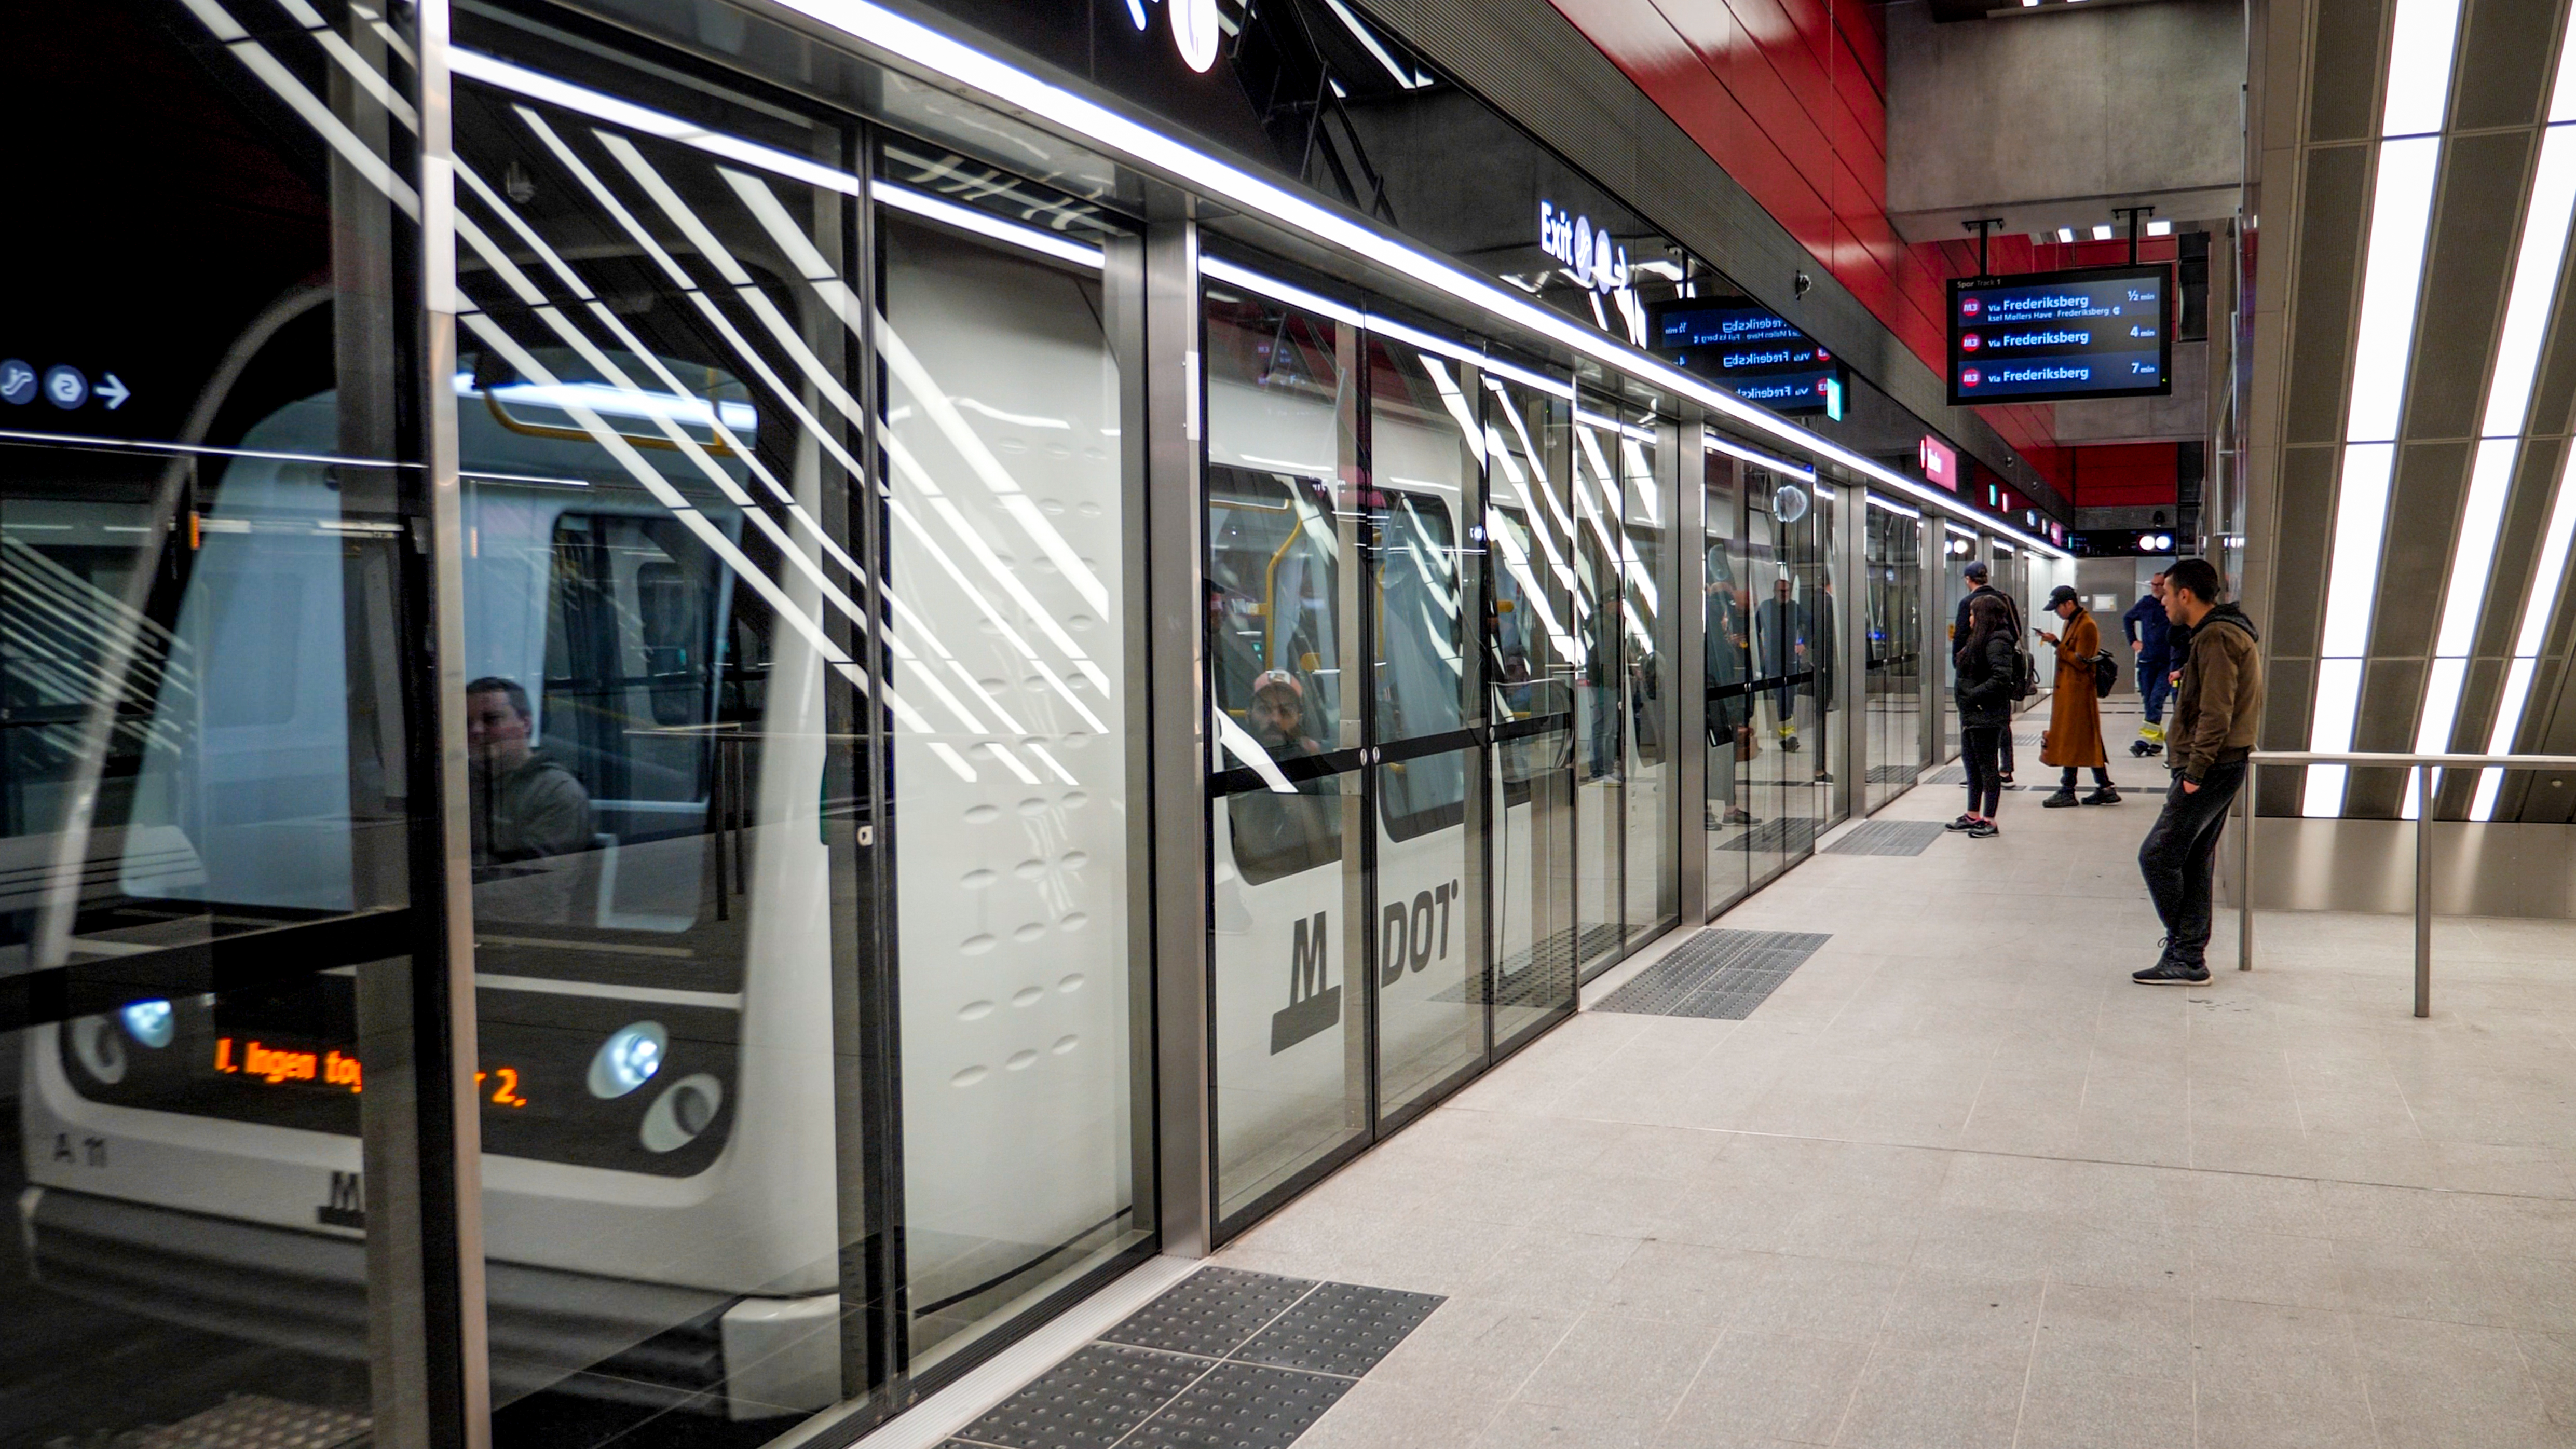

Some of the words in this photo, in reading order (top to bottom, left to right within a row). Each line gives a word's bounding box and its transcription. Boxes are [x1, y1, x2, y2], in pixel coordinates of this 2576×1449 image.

[1542, 201, 1573, 266] Exit
[1964, 304, 1978, 312] M3
[2003, 296, 2089, 310] Frederiksberg
[2057, 308, 2109, 317] Frederiksberg
[1964, 338, 1978, 347] M3
[2003, 331, 2089, 346] Frederiksberg
[2130, 326, 2139, 337] 4
[1964, 374, 1978, 382] M3
[2003, 367, 2089, 381] Frederiksberg
[2131, 362, 2140, 374] 7
